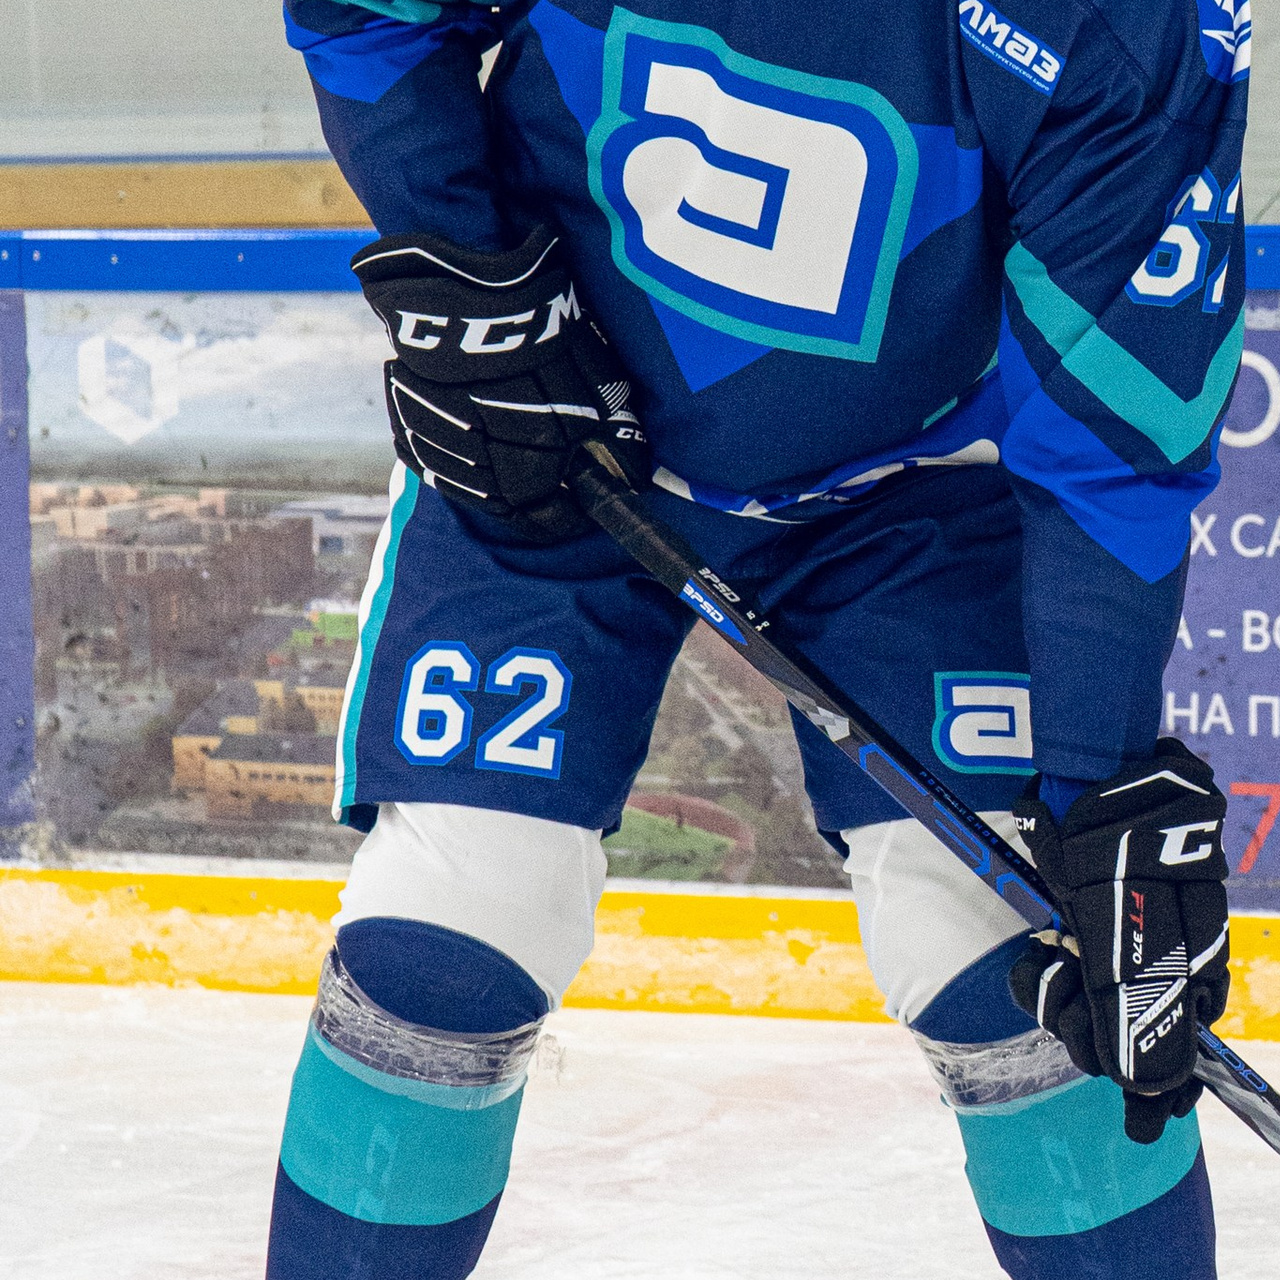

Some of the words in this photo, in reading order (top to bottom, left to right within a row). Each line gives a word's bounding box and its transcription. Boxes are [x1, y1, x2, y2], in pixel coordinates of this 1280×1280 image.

[396, 281, 581, 354] CCM
[393, 640, 573, 780] 62
[1164, 691, 1235, 736] НА
[1138, 1002, 1184, 1054] CCM
